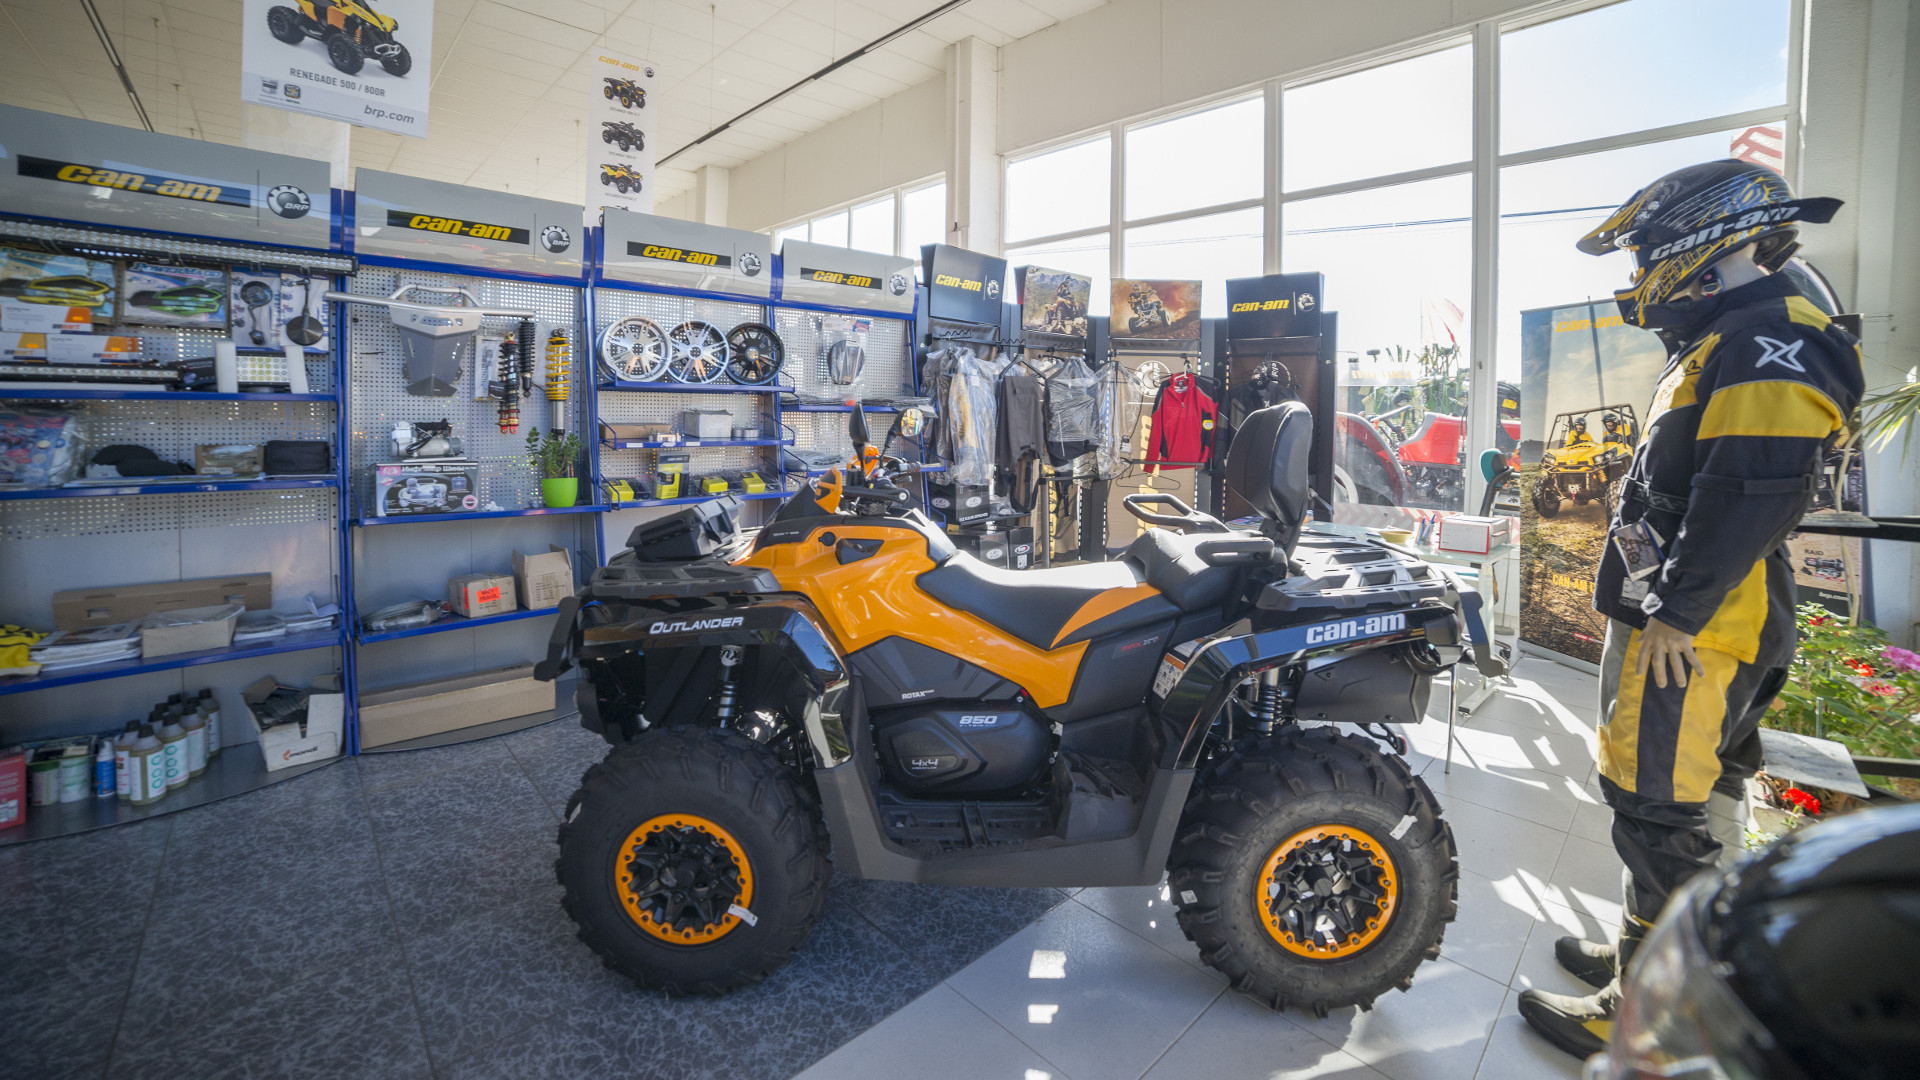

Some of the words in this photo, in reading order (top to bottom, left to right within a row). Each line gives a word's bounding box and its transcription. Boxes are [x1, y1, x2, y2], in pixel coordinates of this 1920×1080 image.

[598, 54, 640, 73] can-am
[289, 67, 338, 87] RENEGADE
[340, 79, 356, 92] 500
[364, 84, 386, 97] 800R
[363, 104, 415, 125] brp.com
[56, 164, 222, 202] can-am
[284, 202, 310, 212] BRP
[409, 214, 512, 241] can-am
[1650, 206, 1800, 261] can-am
[552, 239, 570, 247] BRP
[643, 245, 718, 266] can-am
[812, 270, 872, 288] can-am
[935, 274, 983, 292] can-am
[1231, 299, 1290, 312] can-am
[1555, 315, 1625, 333] can-am
[1804, 548, 1824, 556] RAID
[1552, 573, 1588, 592] CAN-AM
[649, 616, 745, 635] OUTLANDER
[1305, 612, 1406, 645] can-am
[902, 690, 926, 700] ROTAX
[959, 715, 998, 725] 850
[911, 758, 939, 767] 4x4
